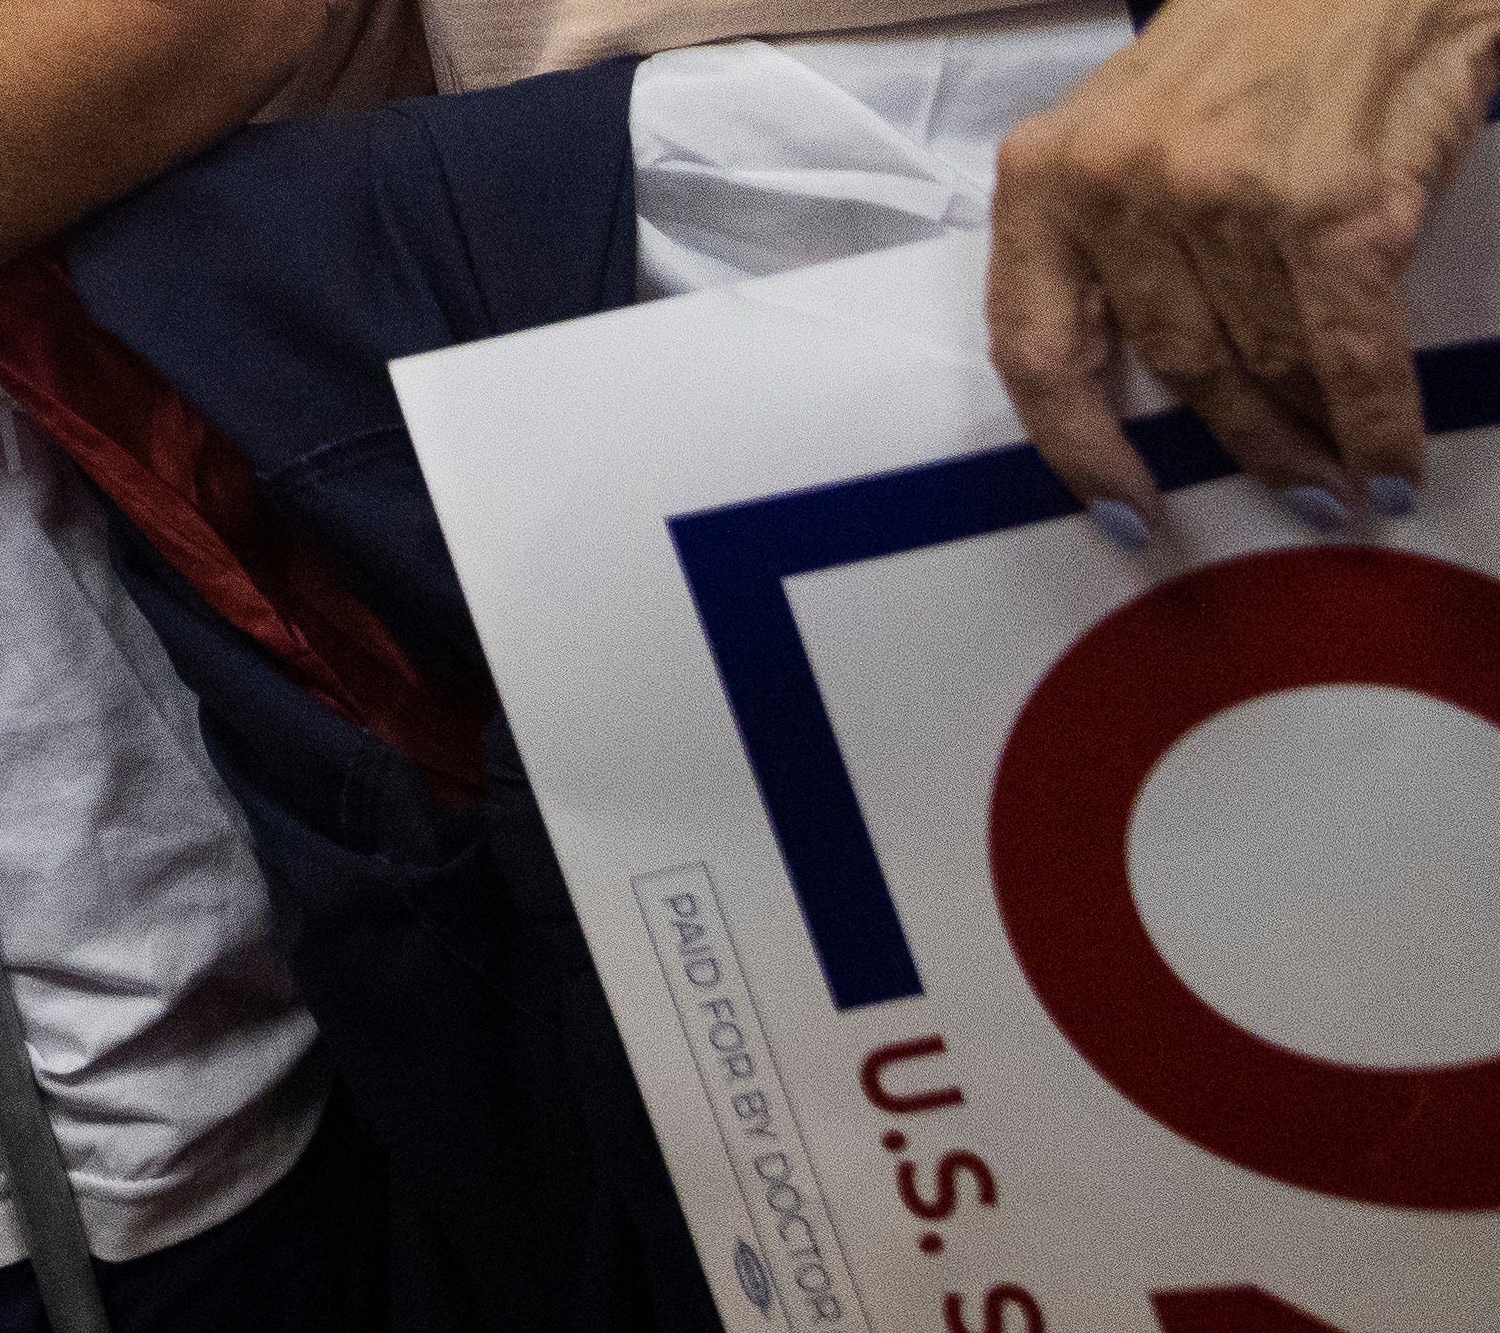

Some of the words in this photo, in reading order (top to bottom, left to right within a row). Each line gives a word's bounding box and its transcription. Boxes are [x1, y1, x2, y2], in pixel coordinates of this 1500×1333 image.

[663, 892, 722, 989] PAID
[700, 997, 756, 1082] FOR
[731, 1090, 777, 1139] BY
[754, 1150, 844, 1324] DOCTOR
[859, 1033, 997, 1255] U.S.
